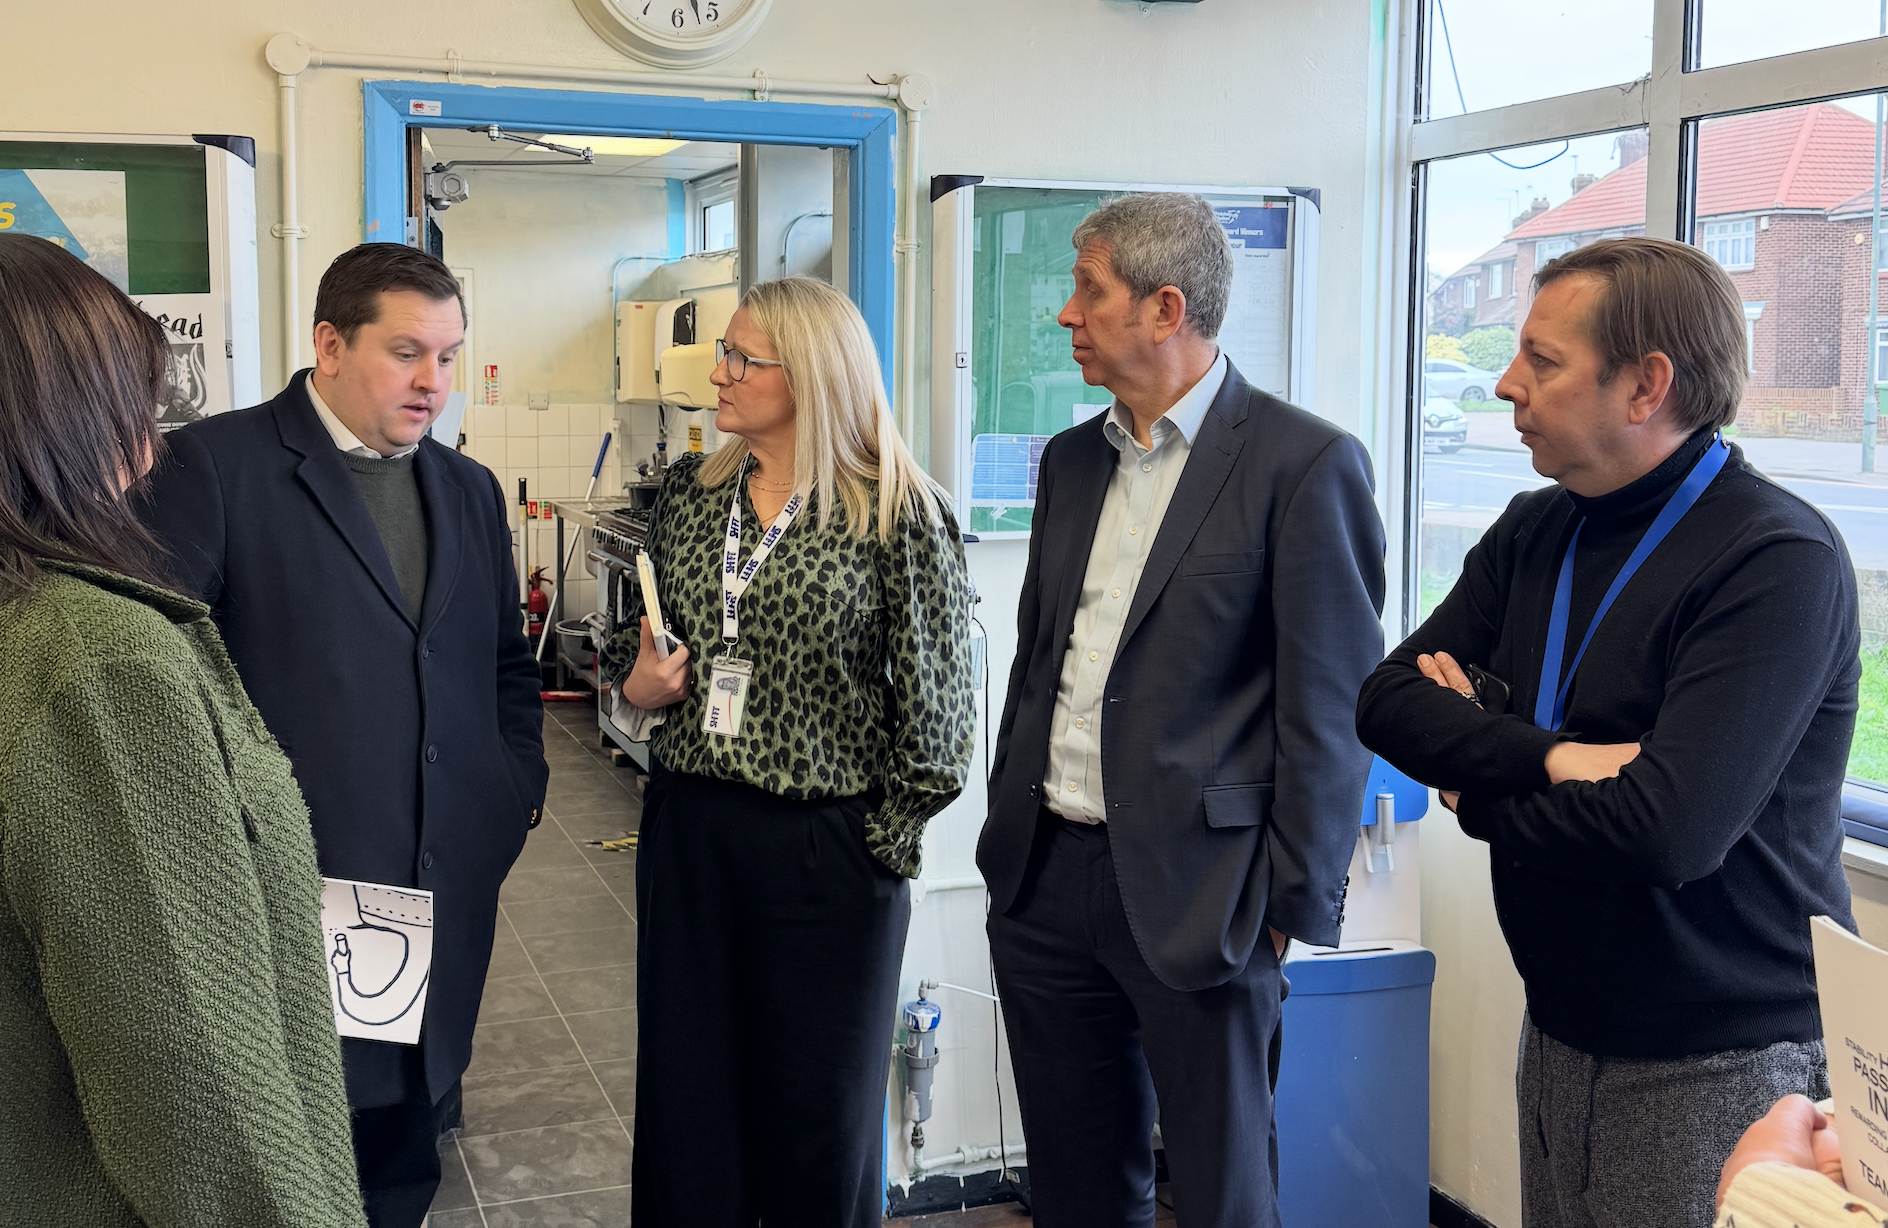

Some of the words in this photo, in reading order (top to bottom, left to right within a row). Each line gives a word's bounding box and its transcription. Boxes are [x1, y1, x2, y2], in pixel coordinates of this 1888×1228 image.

[671, 8, 684, 28] 6
[706, 2, 719, 21] 5
[1845, 1036, 1877, 1065] STABILITY
